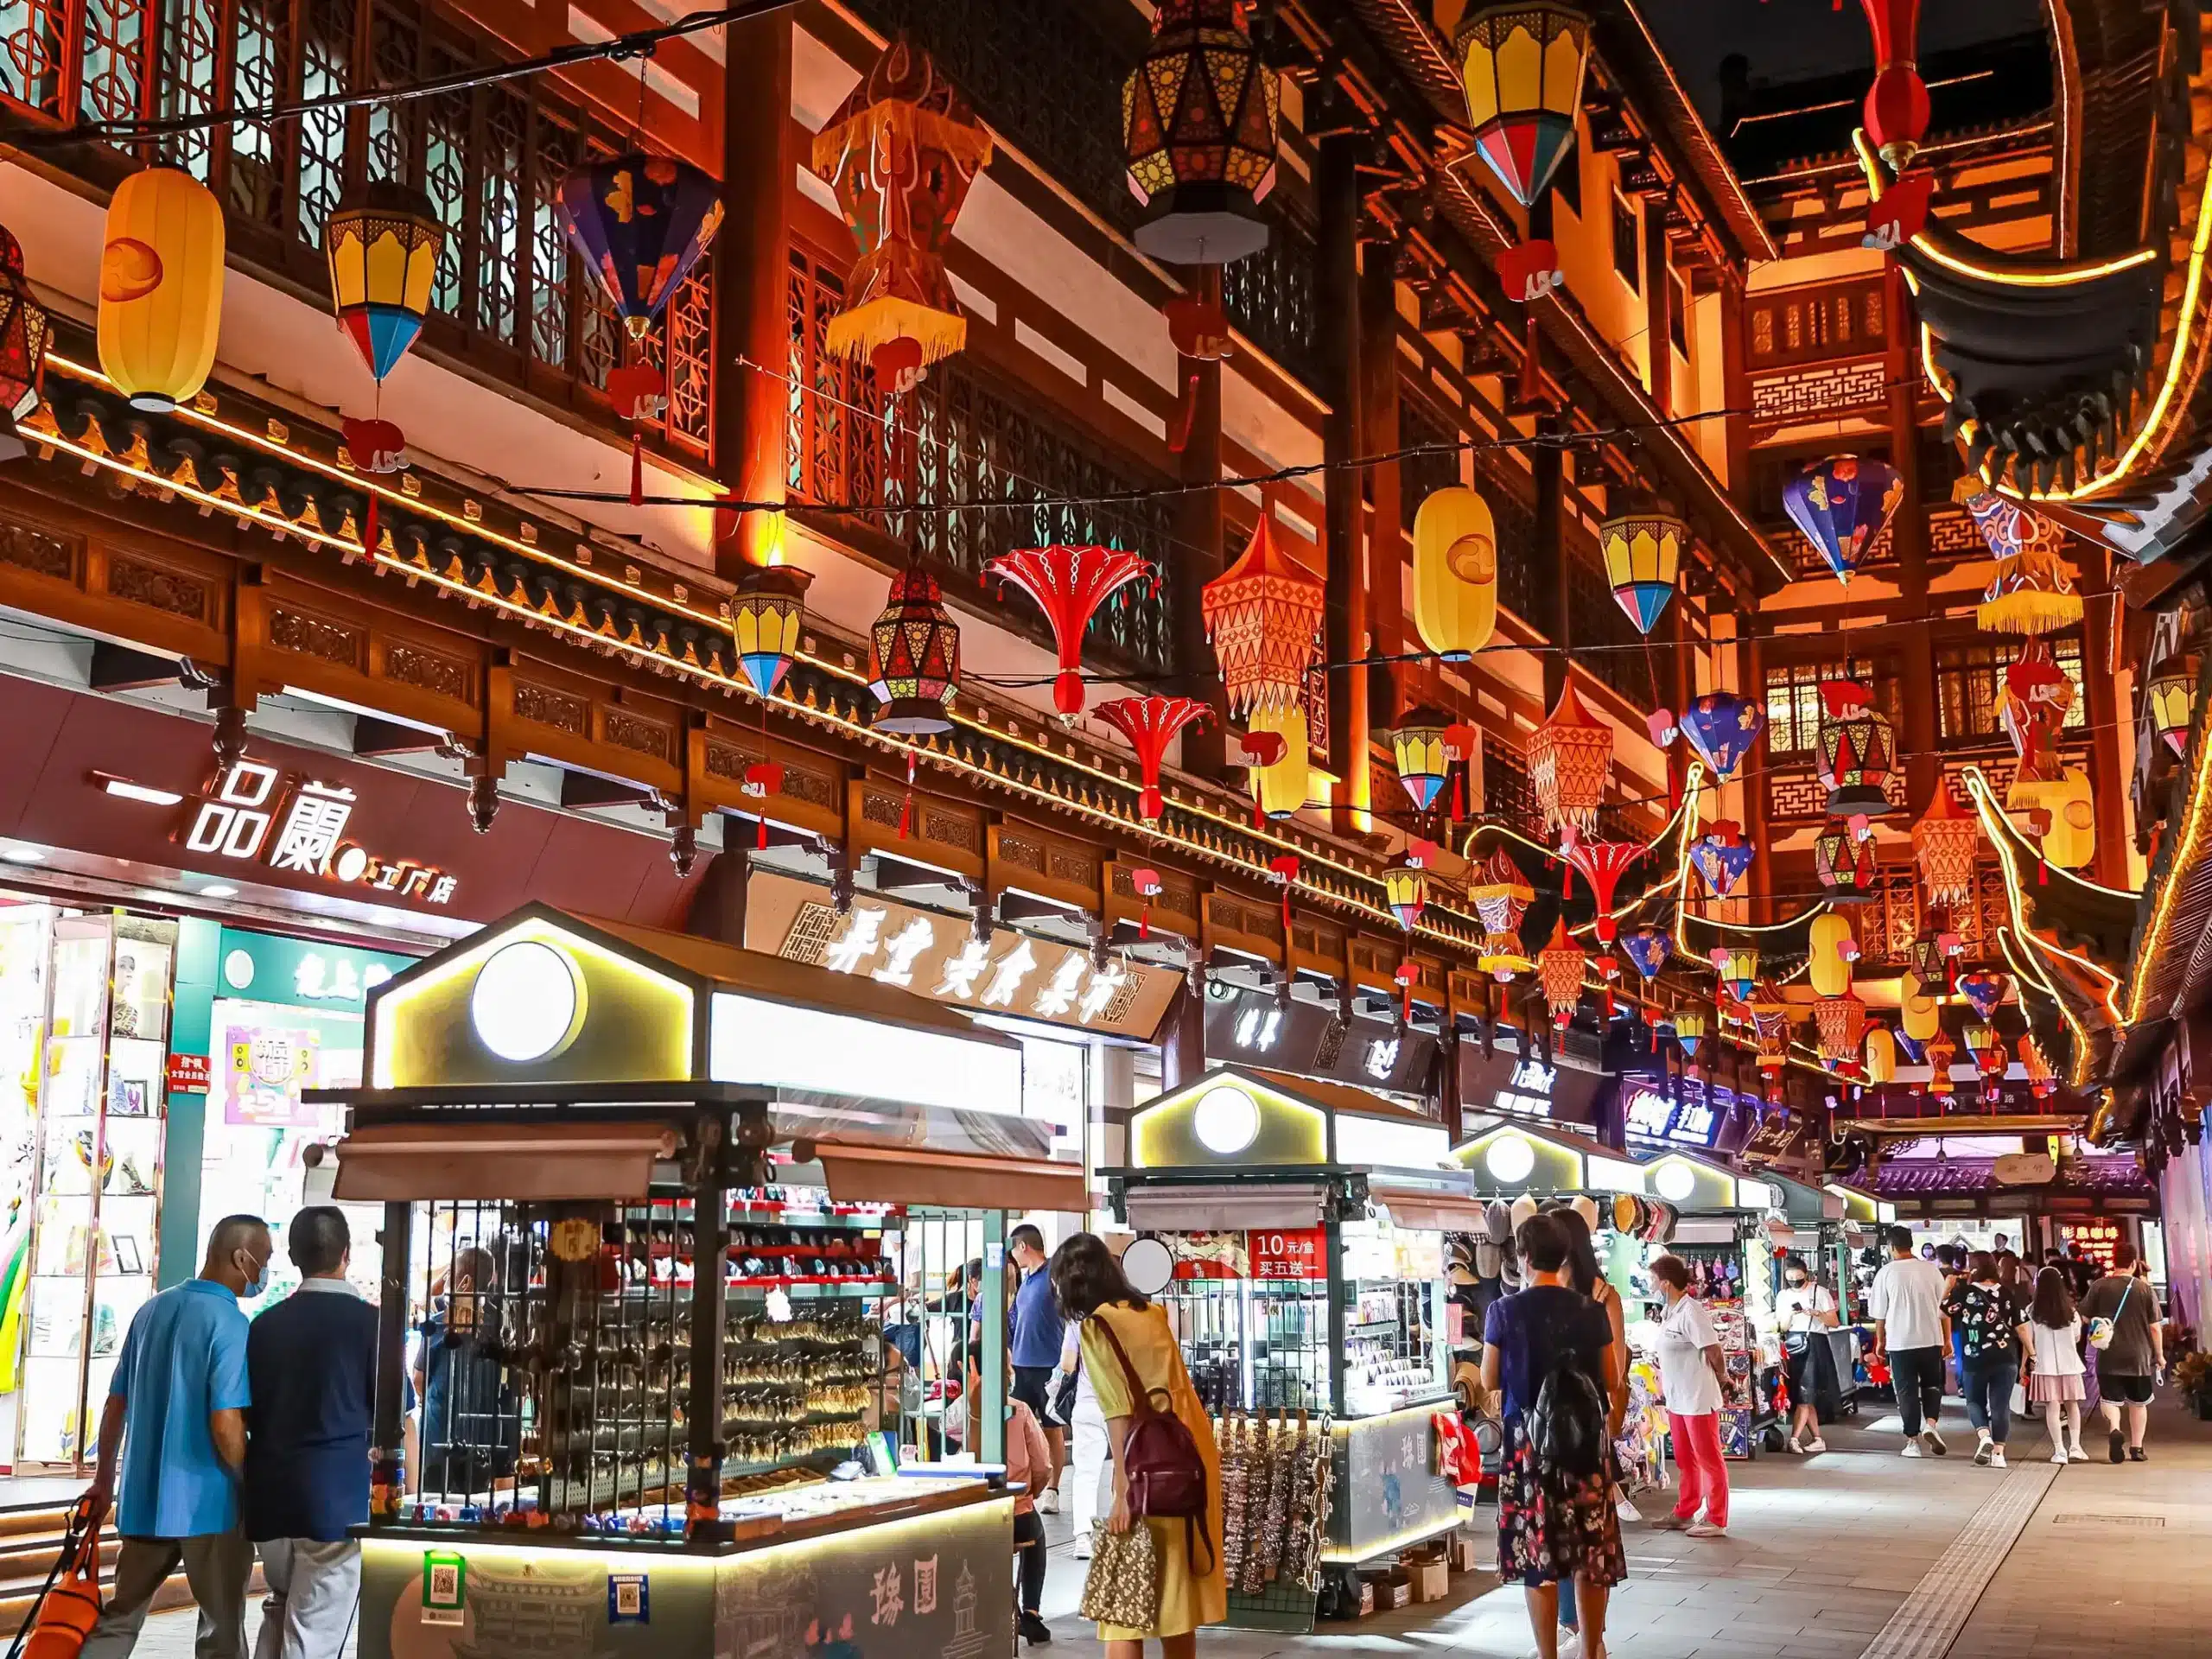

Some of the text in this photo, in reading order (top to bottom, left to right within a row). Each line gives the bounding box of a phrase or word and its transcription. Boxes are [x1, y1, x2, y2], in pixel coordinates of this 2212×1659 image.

[372, 865, 458, 906] 工厂店
[1259, 1261, 1319, 1276] 买五送一
